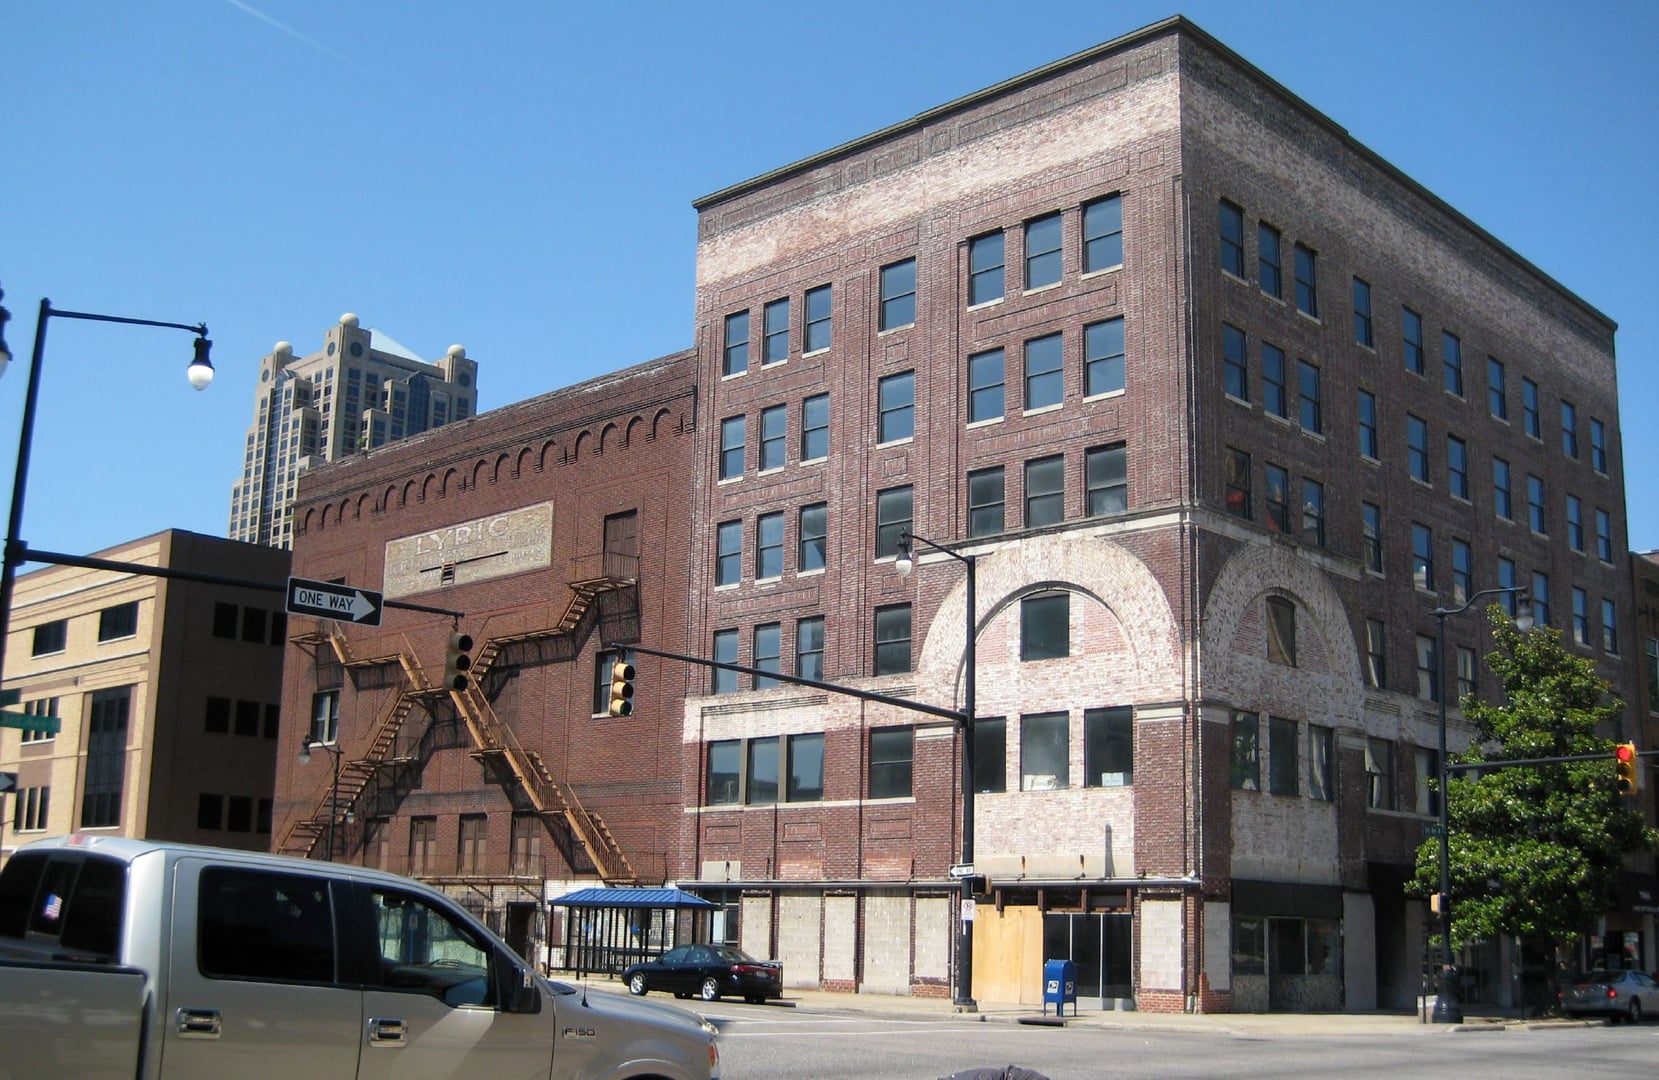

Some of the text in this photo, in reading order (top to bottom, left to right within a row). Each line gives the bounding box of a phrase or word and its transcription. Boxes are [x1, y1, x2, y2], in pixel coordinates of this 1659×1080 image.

[416, 516, 509, 555] LYRIC
[299, 590, 354, 611] ONE WAY
